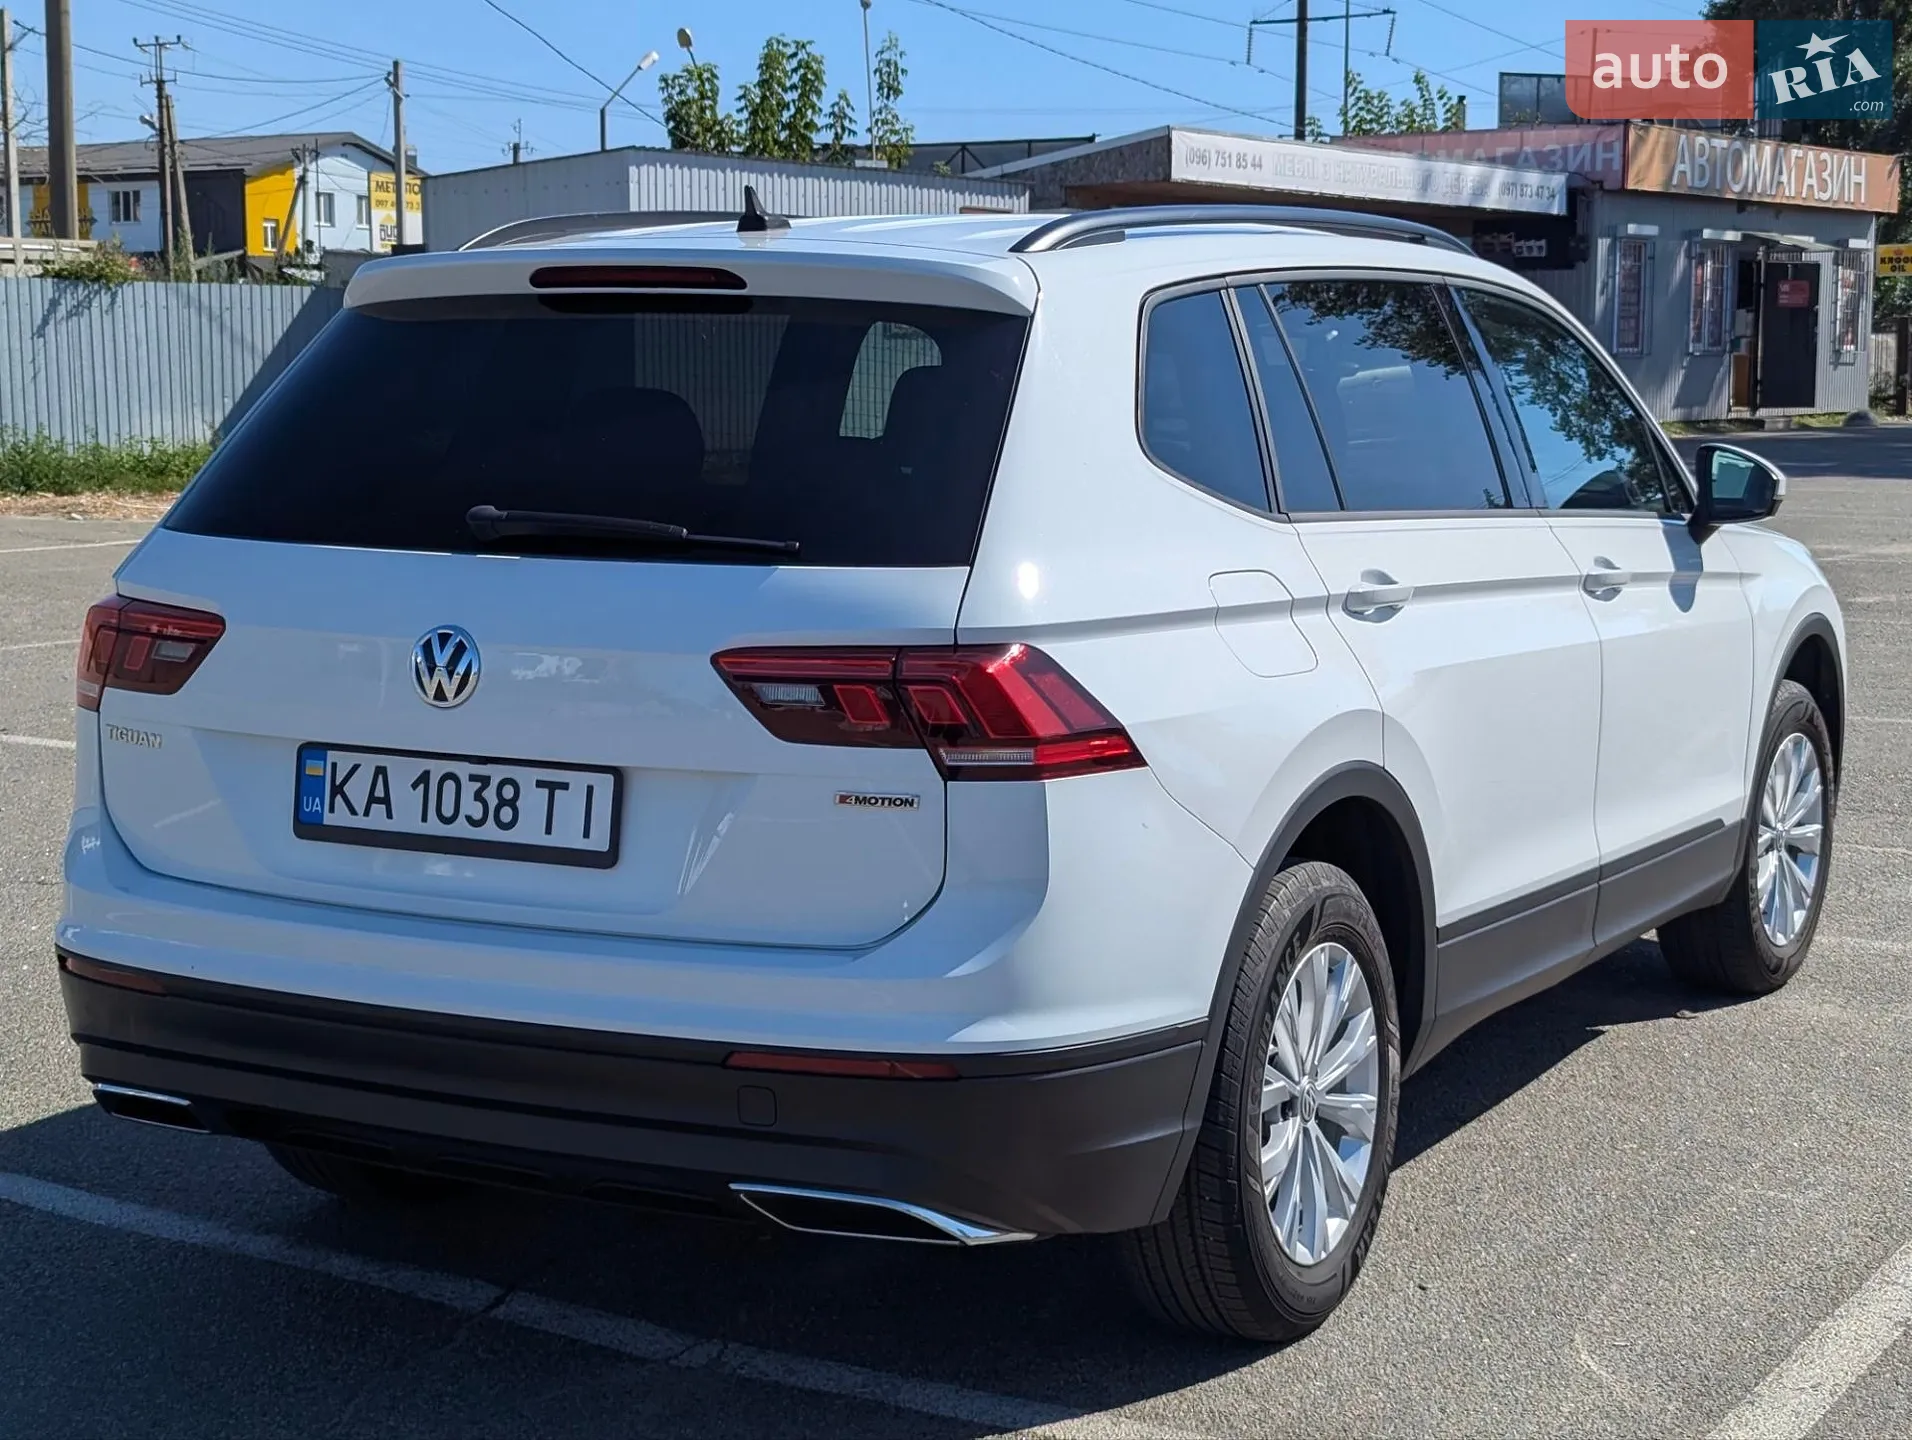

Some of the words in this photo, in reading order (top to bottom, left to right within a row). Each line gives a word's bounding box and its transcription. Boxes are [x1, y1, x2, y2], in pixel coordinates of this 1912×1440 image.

[1185, 146, 1212, 170] (096)
[1215, 149, 1233, 168] 751
[1236, 152, 1248, 169] 85
[1251, 153, 1263, 171] 44
[1672, 134, 1867, 204] АВТОМАГАЗИН
[106, 723, 163, 750] TIGUAN
[303, 796, 323, 814] UA
[328, 761, 394, 821] KA
[410, 768, 521, 831] 1038
[839, 793, 916, 809] 4MOTION
